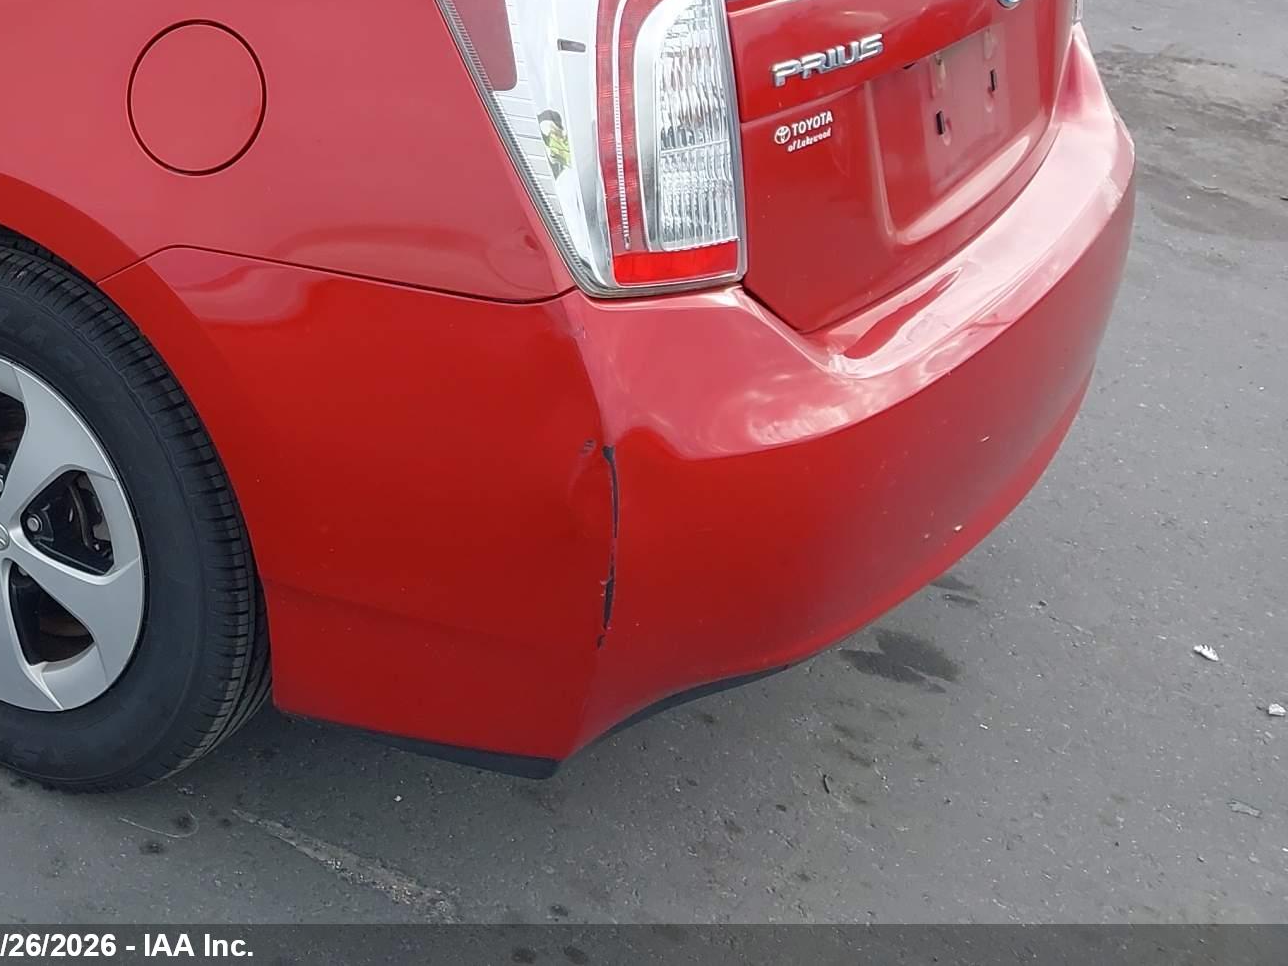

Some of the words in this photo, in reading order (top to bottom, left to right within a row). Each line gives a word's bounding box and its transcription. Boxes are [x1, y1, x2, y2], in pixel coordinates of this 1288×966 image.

[772, 33, 883, 87] PRIUS
[792, 111, 833, 136] TOYOTA
[797, 128, 831, 149] Lakewood
